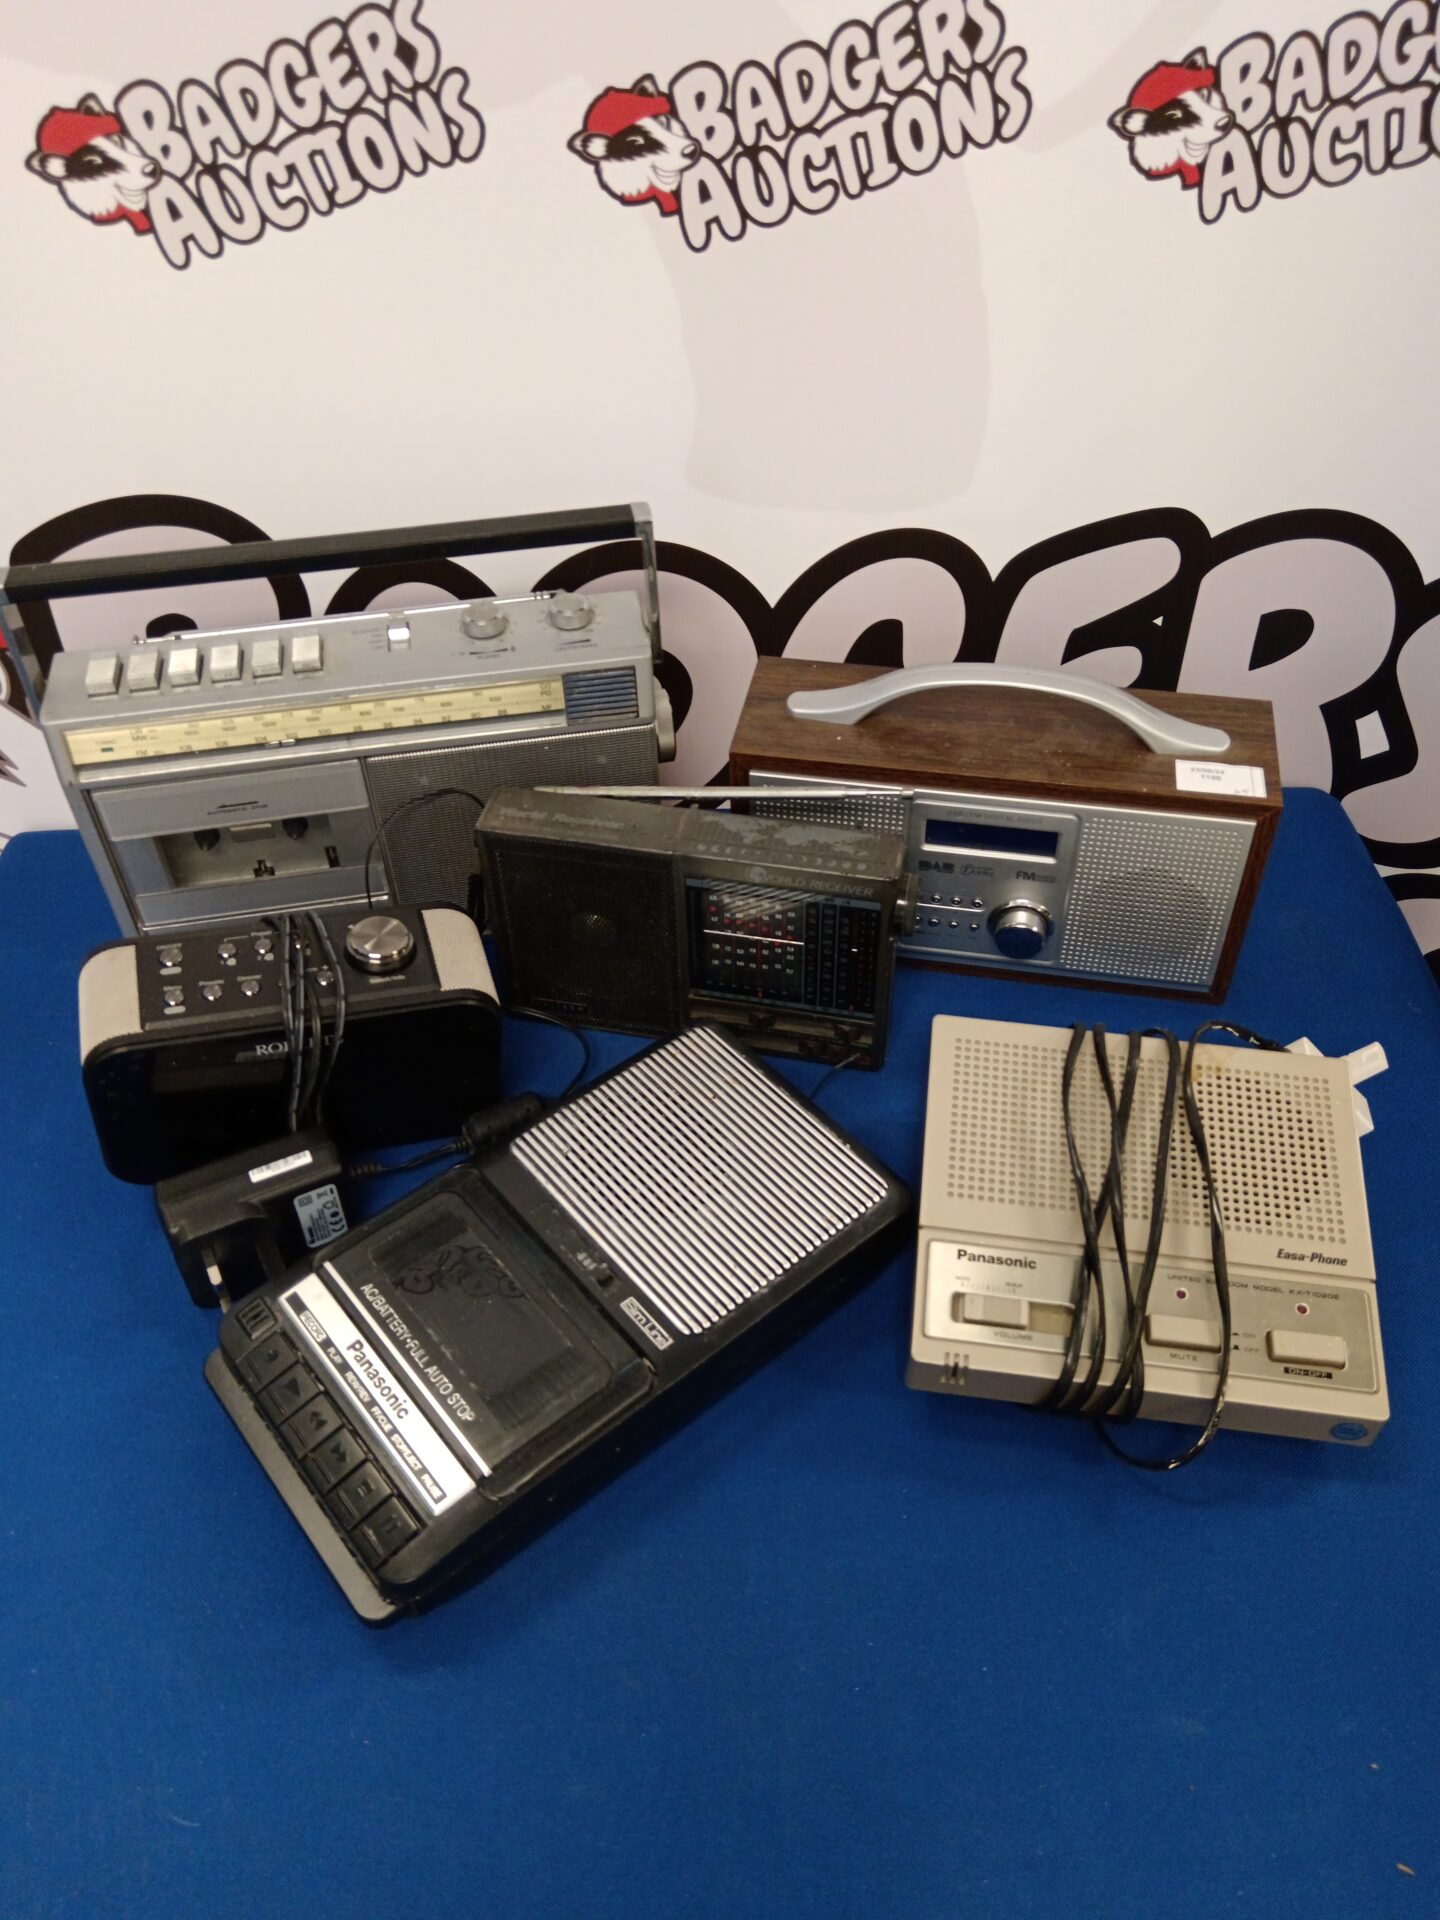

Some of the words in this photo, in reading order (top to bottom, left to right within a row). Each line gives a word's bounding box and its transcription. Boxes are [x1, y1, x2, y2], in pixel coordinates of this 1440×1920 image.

[114, 0, 441, 182] BADGERS
[1216, 0, 1440, 134] BADG
[150, 67, 486, 270] AUCTIONS
[679, 46, 1033, 253] AUCTIONS
[1199, 78, 1440, 225] AUCTI
[957, 1248, 1038, 1270] Panasonic
[1276, 1248, 1348, 1267] Easa-Phone
[346, 1339, 409, 1420] Panasonic
[424, 1365, 454, 1396] AUTO
[447, 1392, 476, 1422] STOP
[1169, 1352, 1199, 1362] MUTE
